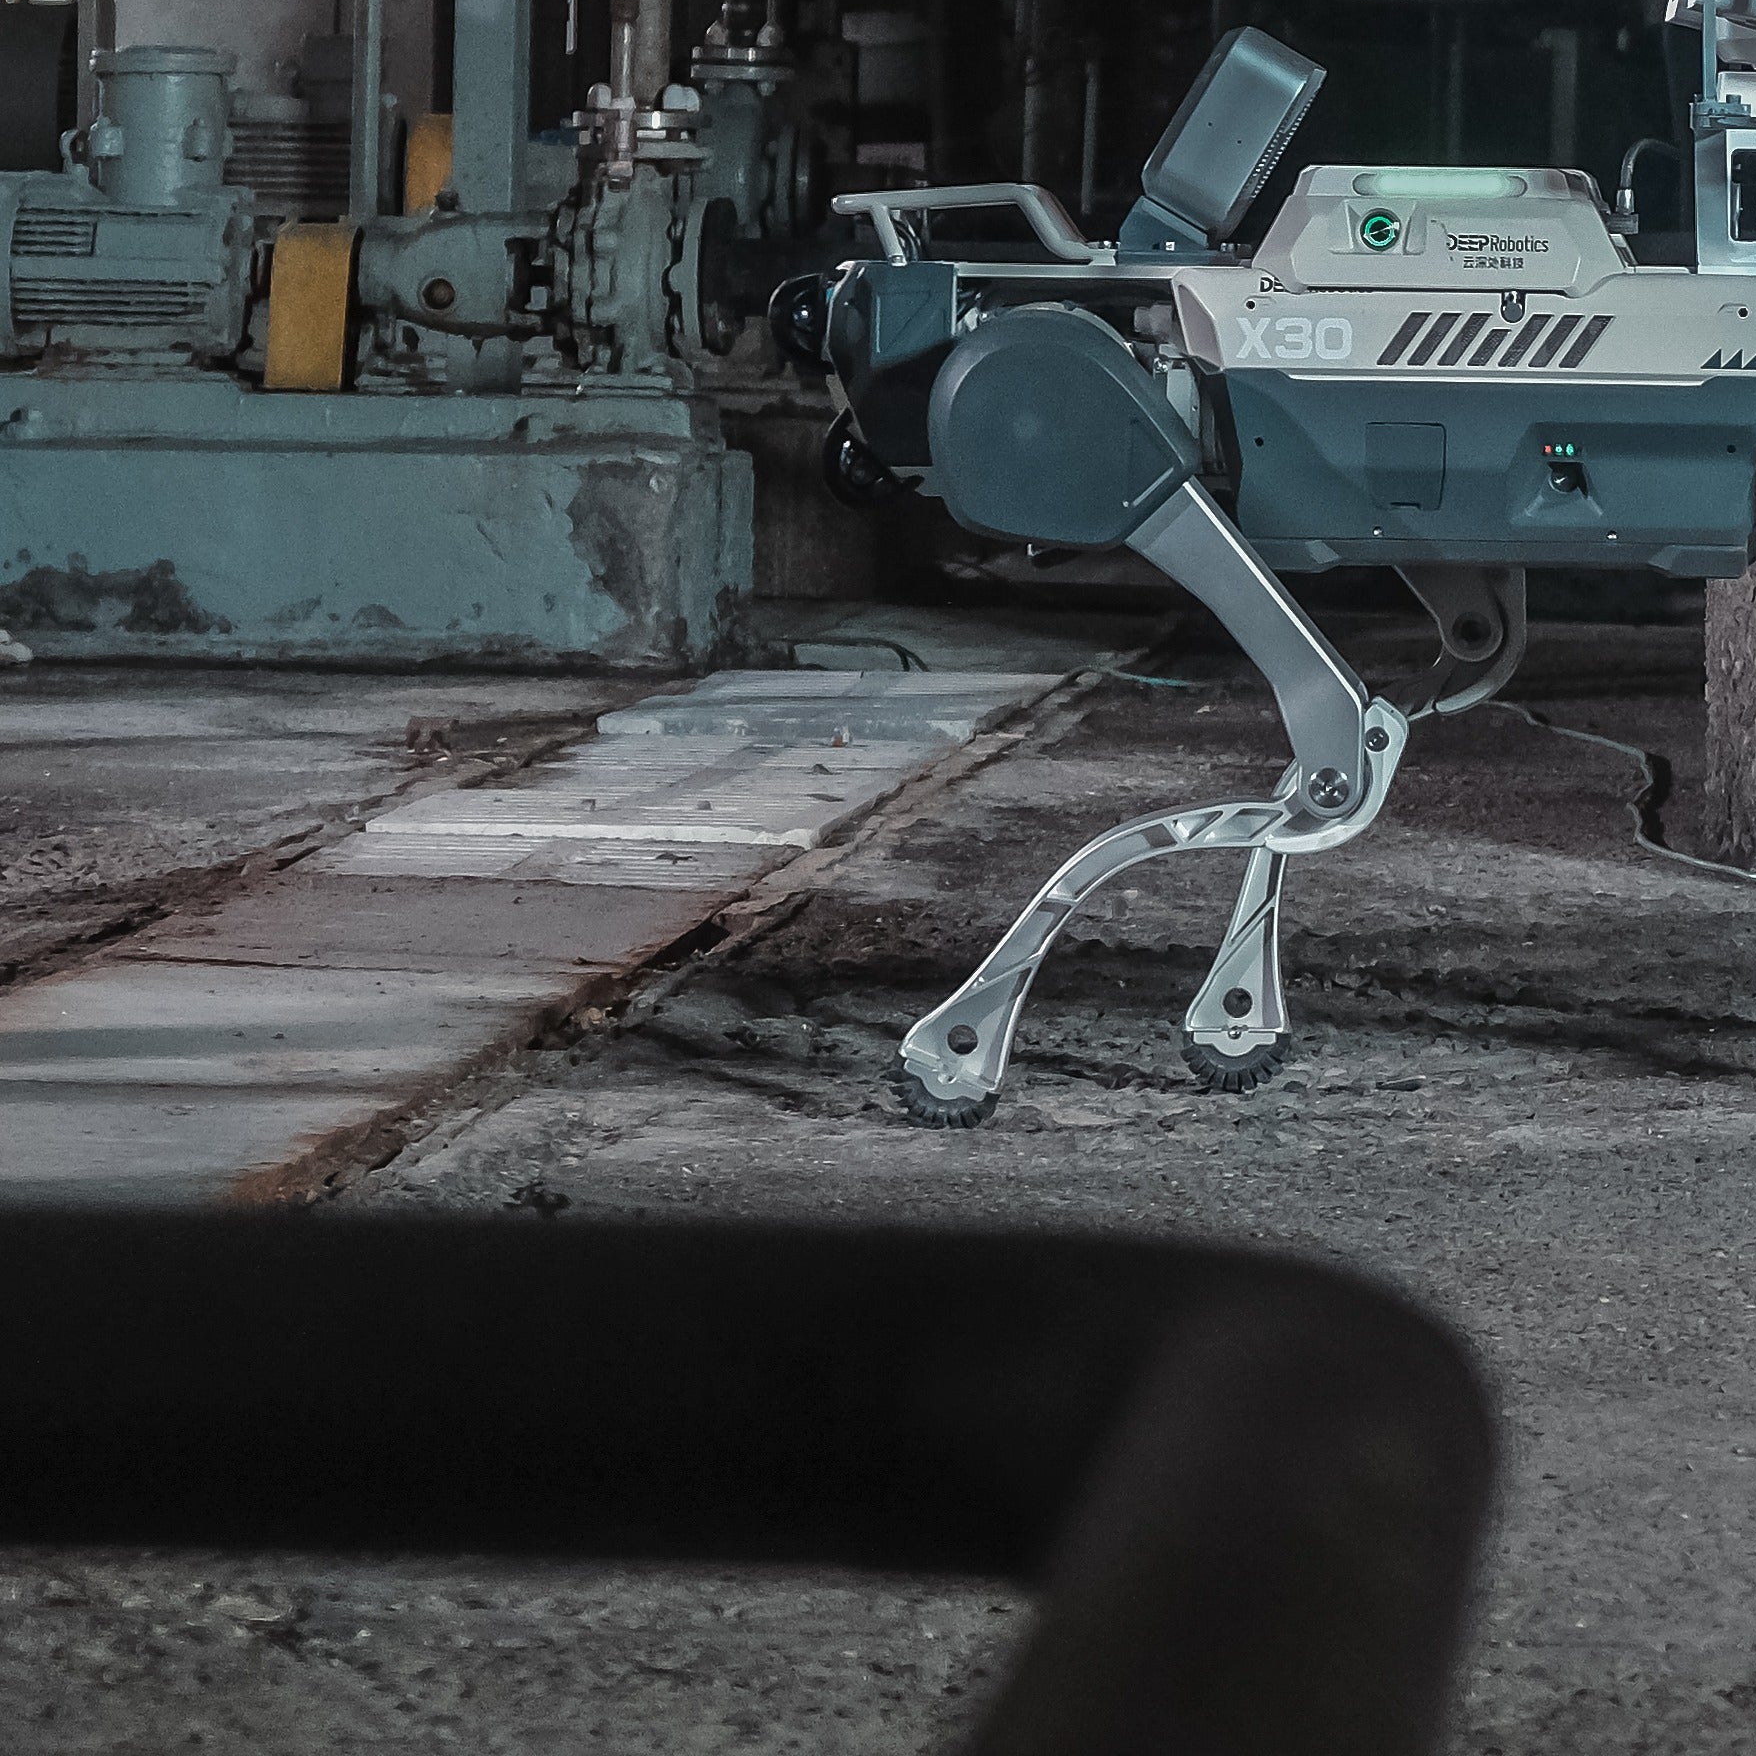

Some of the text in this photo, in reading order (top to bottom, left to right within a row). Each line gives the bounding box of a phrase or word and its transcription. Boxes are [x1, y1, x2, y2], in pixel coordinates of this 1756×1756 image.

[1463, 256, 1524, 270] 云深处科技
[1236, 317, 1353, 360] X30
